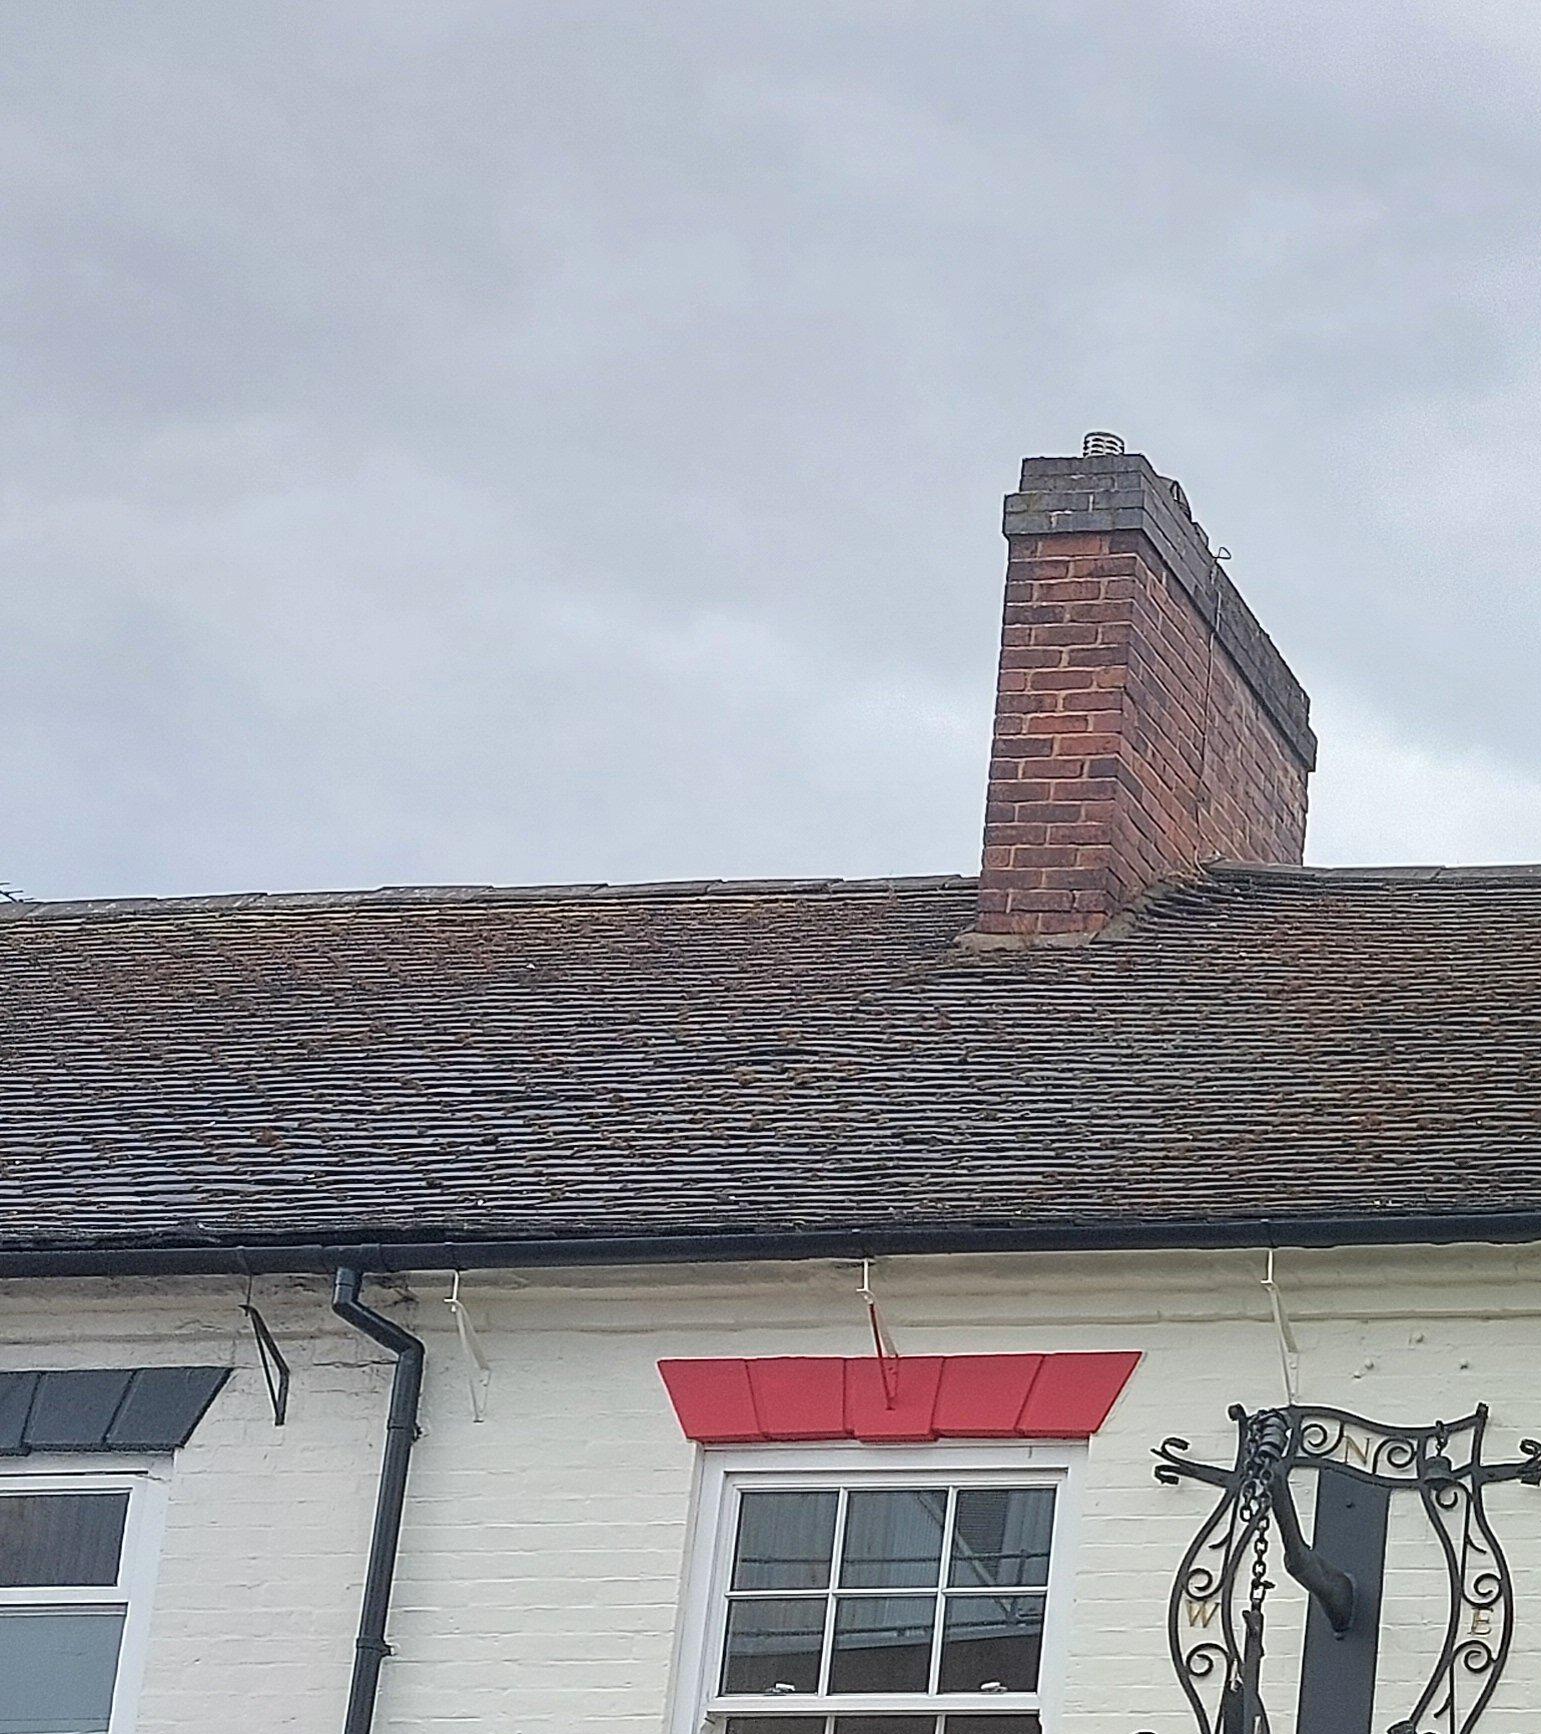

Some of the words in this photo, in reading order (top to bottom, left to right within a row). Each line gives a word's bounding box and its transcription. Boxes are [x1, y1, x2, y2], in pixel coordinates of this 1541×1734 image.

[1341, 1436, 1372, 1468] N
[1184, 1600, 1220, 1630] W
[1467, 1607, 1494, 1636] E
